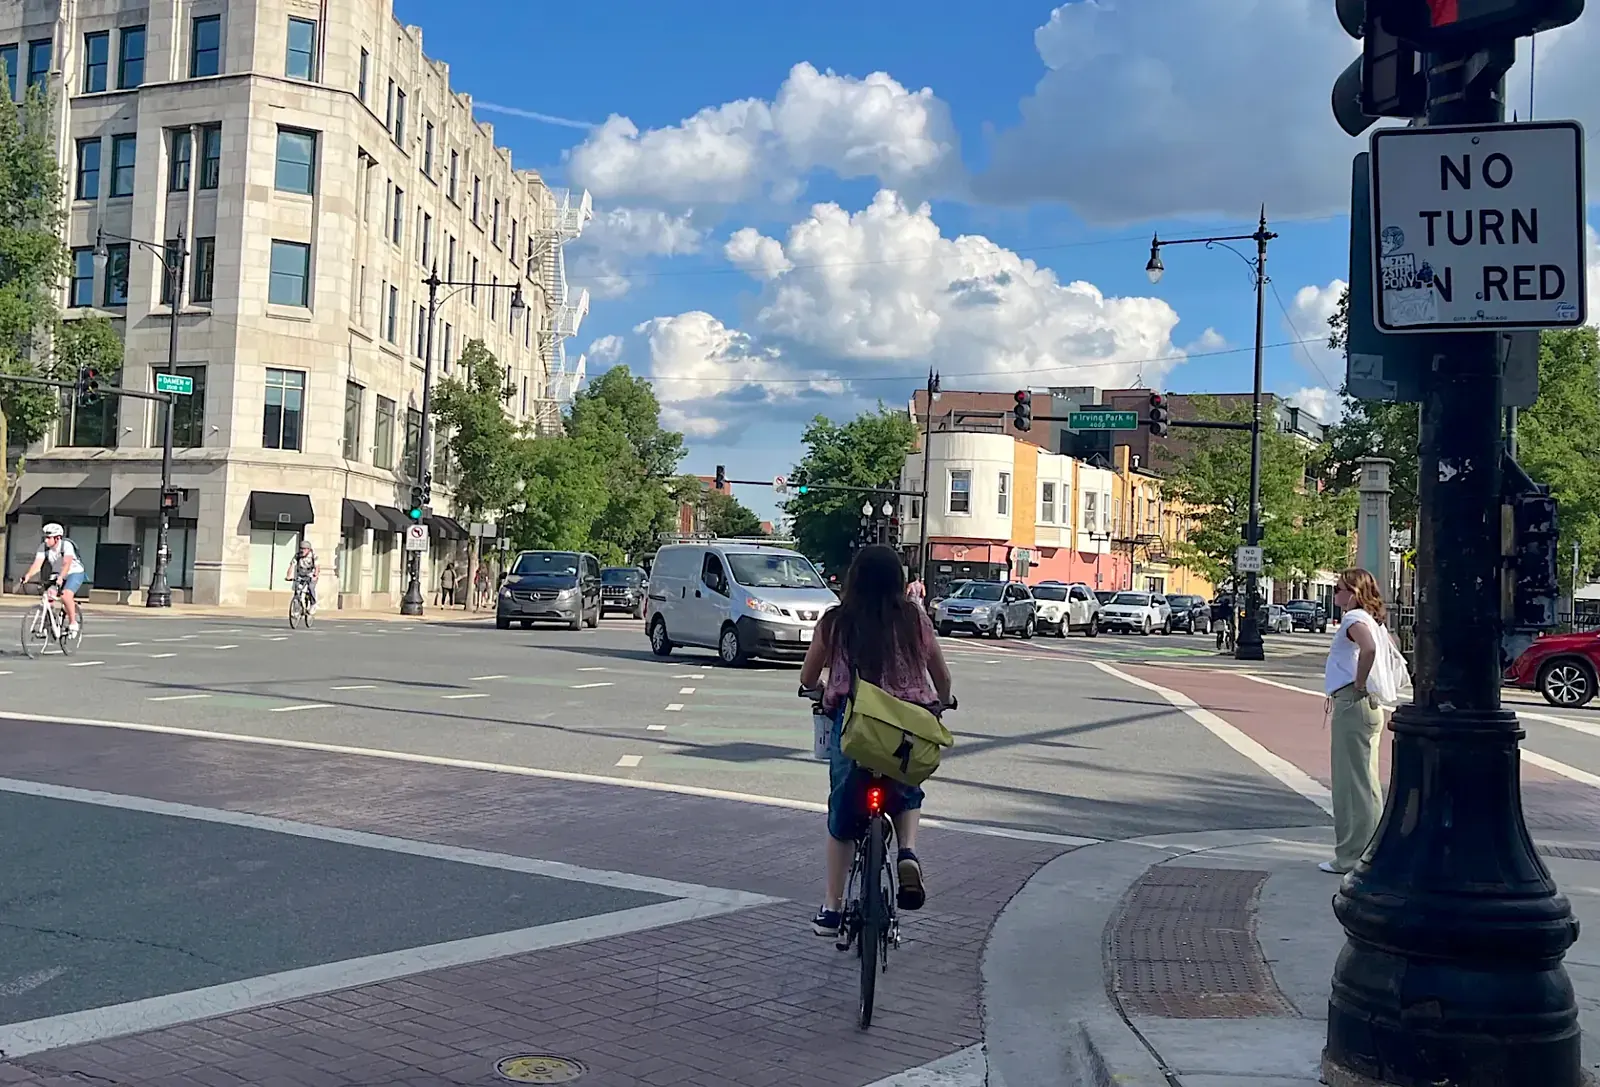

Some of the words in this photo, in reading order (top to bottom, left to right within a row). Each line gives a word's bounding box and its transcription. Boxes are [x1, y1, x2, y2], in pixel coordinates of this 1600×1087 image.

[1440, 152, 1513, 190] NO
[1419, 208, 1538, 246] TURN
[1383, 275, 1416, 290] PONY
[1483, 264, 1566, 301] RED
[163, 377, 184, 385] DAMEN
[1080, 414, 1104, 423] Irving
